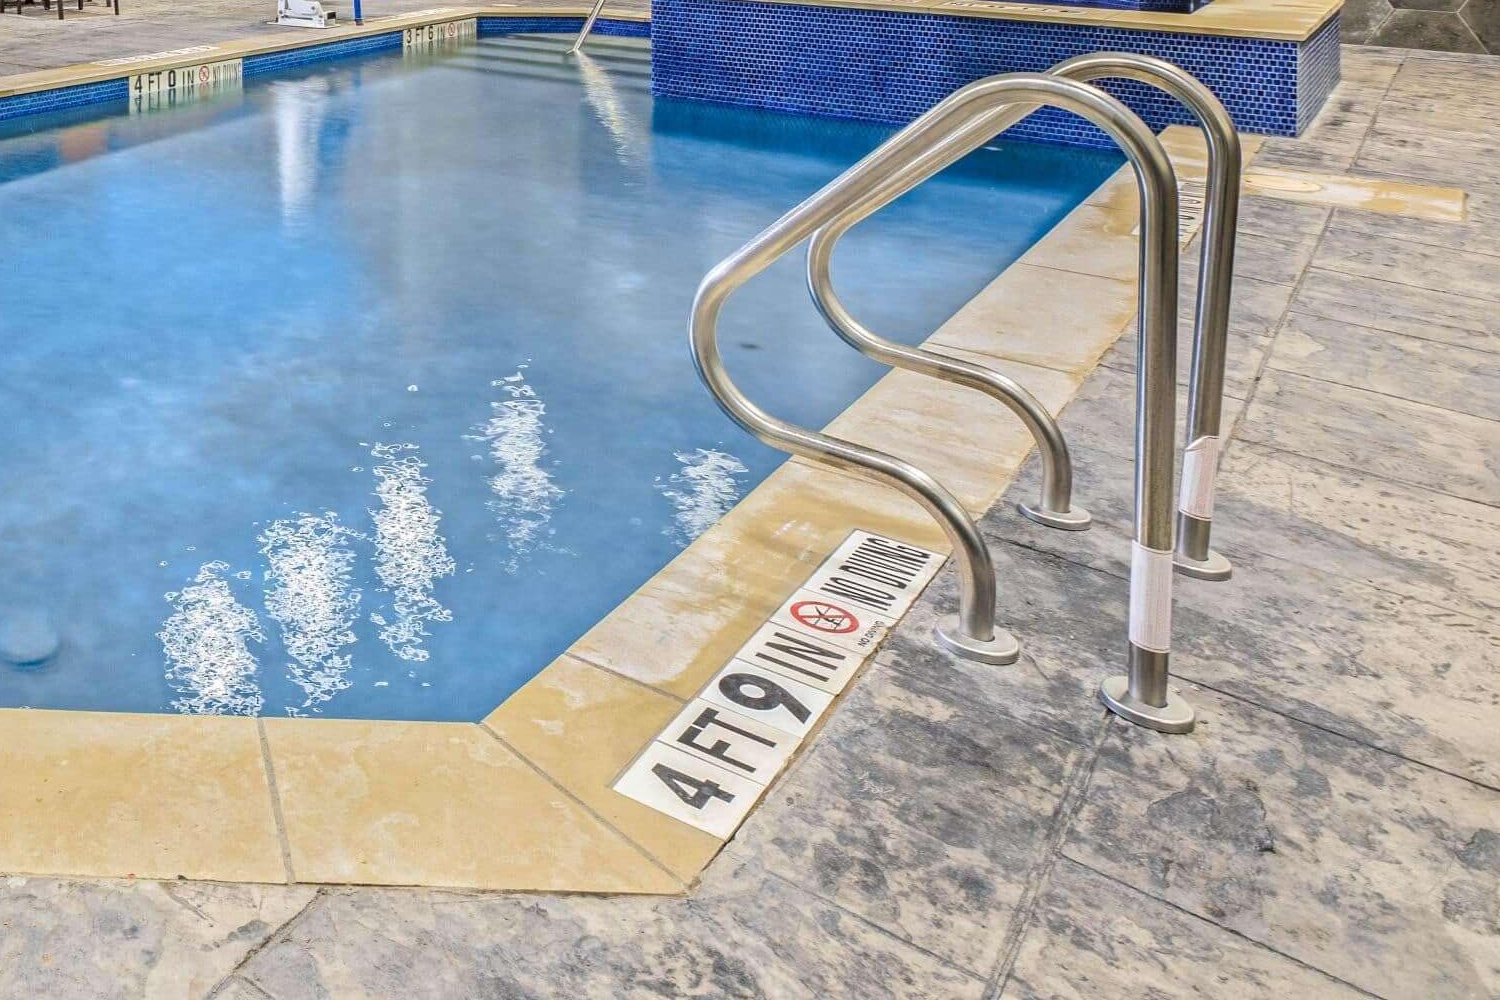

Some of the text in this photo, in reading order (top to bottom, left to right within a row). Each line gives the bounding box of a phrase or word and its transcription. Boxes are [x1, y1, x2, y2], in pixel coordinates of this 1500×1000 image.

[407, 29, 412, 44] 3
[416, 27, 425, 41] FT
[428, 25, 434, 40] 6
[135, 75, 143, 93] 4
[148, 71, 162, 91] FT
[182, 70, 195, 85] IN
[857, 637, 871, 648] NO
[652, 536, 930, 810] 4 FT 9 IN NO DIVING
